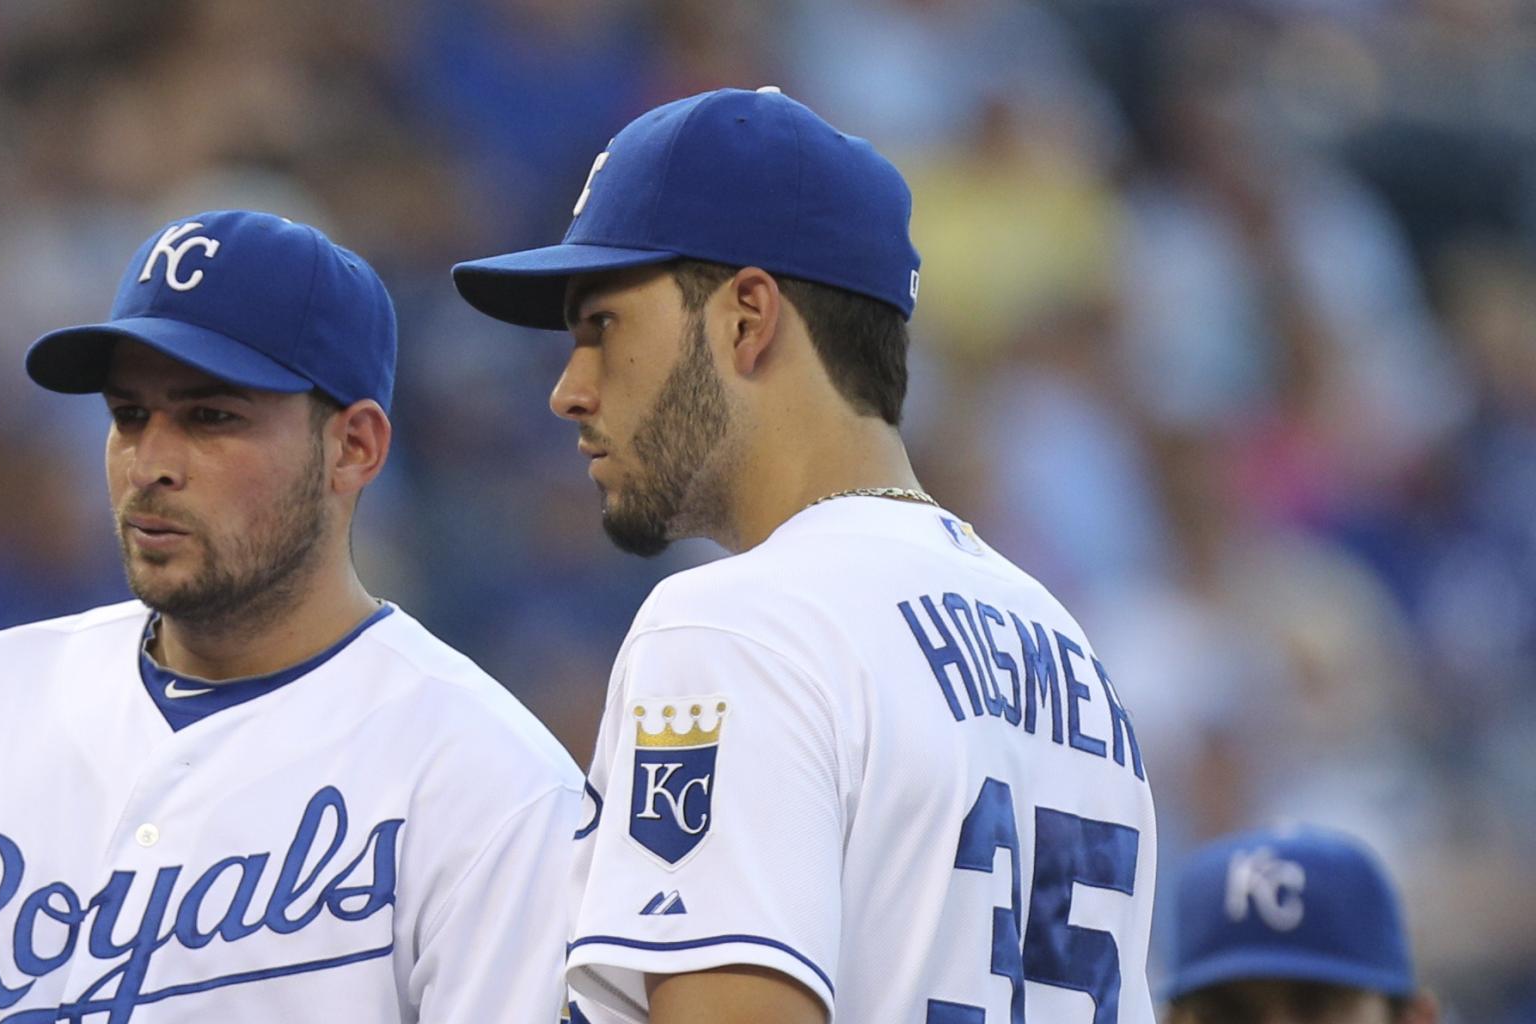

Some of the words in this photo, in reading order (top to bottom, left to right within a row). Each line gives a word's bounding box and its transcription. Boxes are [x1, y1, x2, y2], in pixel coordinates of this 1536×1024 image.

[137, 221, 221, 292] KC
[896, 591, 1145, 782] HOSMER
[635, 762, 711, 835] KC
[1224, 847, 1306, 931] KC
